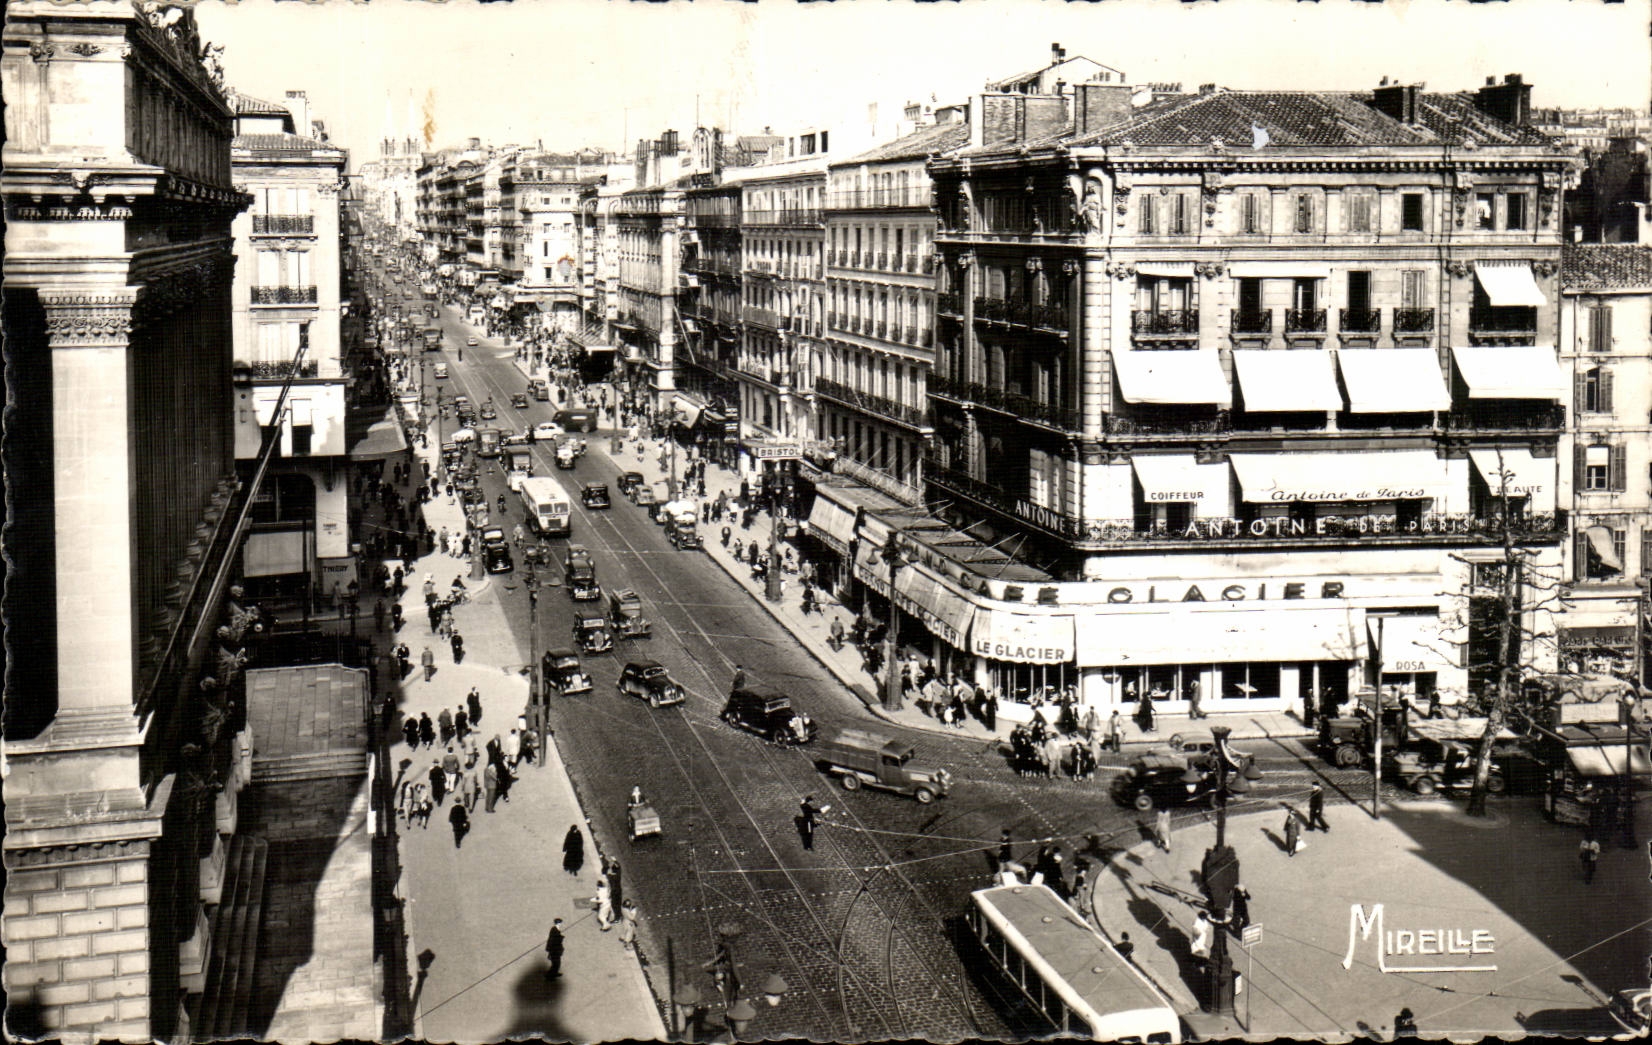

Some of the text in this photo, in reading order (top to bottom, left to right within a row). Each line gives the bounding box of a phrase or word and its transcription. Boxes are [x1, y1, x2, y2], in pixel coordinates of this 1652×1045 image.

[760, 448, 801, 457] BRISTOL
[1150, 491, 1205, 501] COIFFEUR
[1271, 488, 1425, 501] Antoine de Paris
[1015, 499, 1066, 534] ANTOINE
[1184, 518, 1470, 537] ANTOINE DE PARIS
[1107, 581, 1345, 604] GLACIER
[976, 640, 1066, 661] LE GLACIER
